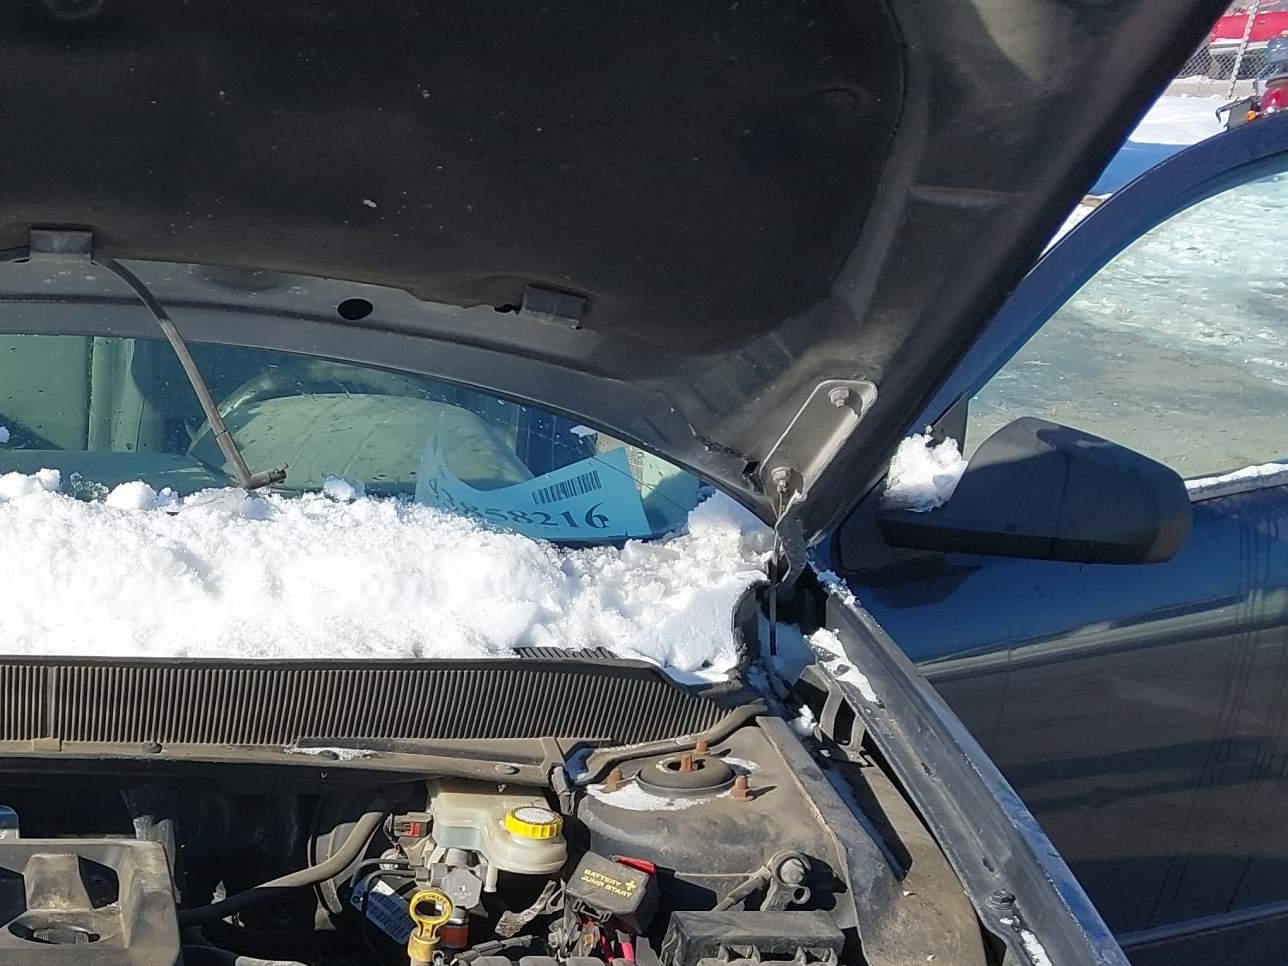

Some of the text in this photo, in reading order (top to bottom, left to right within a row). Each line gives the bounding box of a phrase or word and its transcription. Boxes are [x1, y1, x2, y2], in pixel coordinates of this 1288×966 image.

[581, 875, 632, 898] JUMP START
[584, 868, 622, 886] BATTERY
